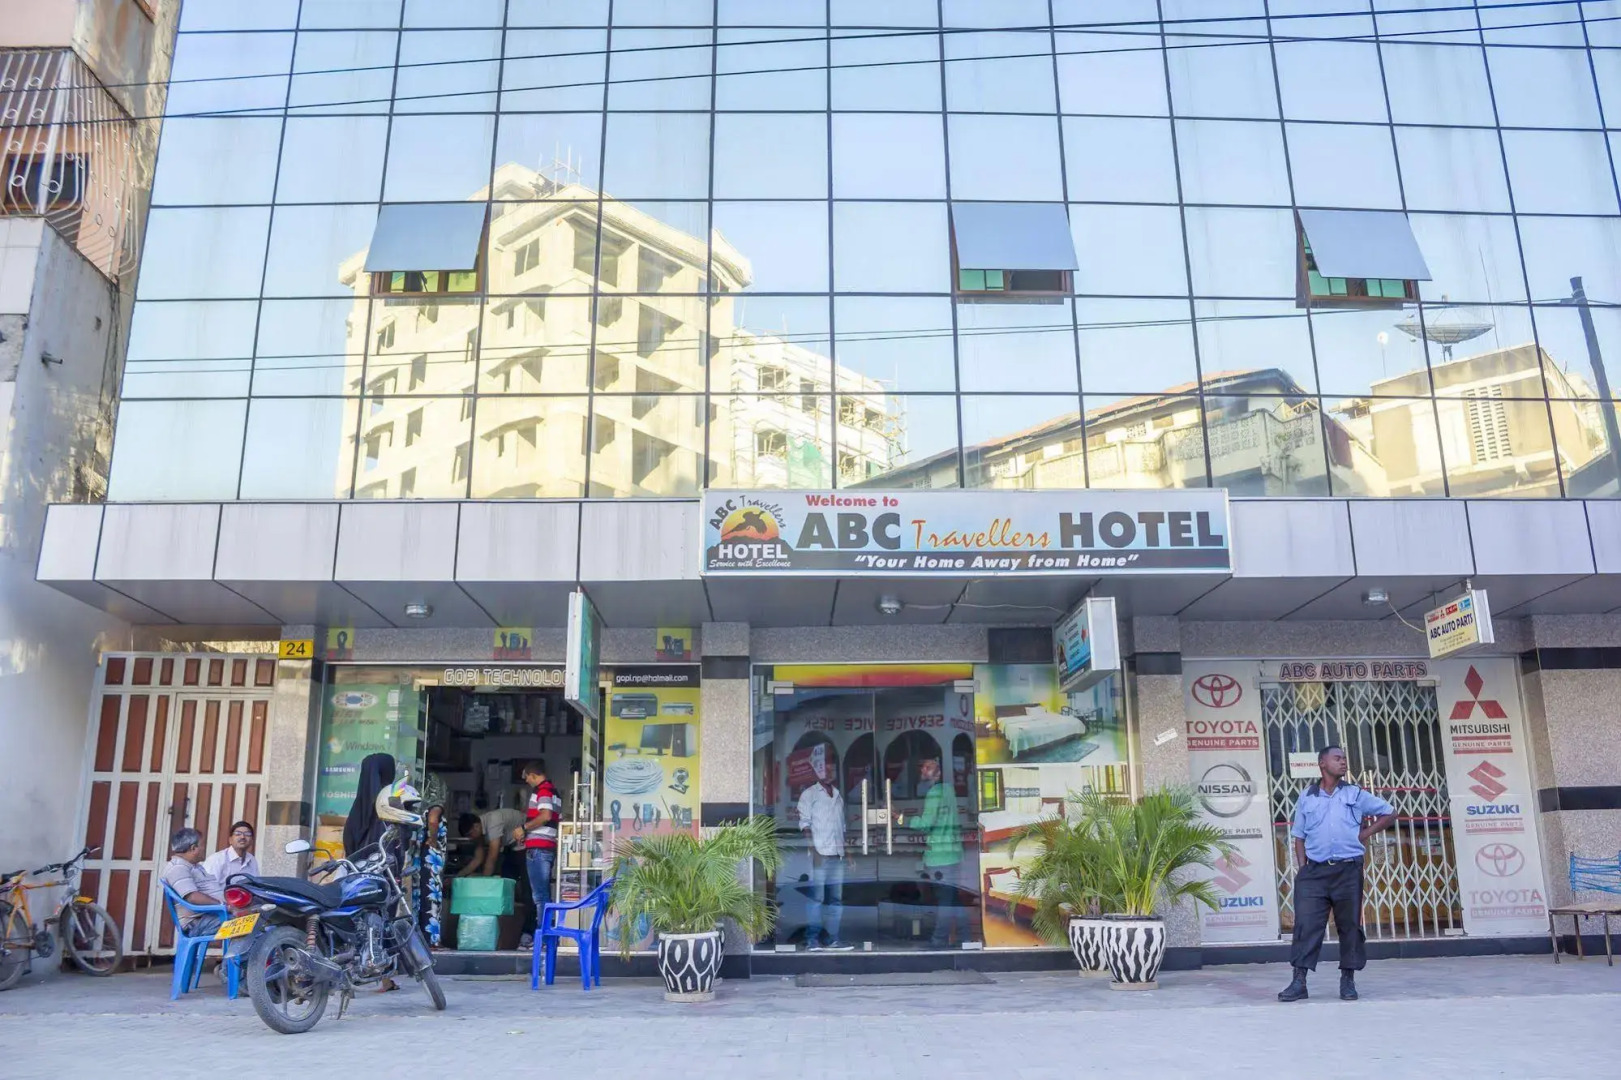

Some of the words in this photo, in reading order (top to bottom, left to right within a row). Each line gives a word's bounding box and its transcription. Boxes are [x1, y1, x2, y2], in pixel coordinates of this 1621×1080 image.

[806, 495, 877, 506] Welcome
[882, 496, 899, 506] to
[709, 499, 737, 530] ABC
[739, 495, 786, 528] Travellers
[796, 512, 901, 550] ABC
[911, 518, 1051, 550] Travellers
[1059, 511, 1223, 548] HOTEL
[719, 544, 788, 559] HOTEL
[709, 559, 735, 568] Service
[737, 559, 753, 567] with
[756, 558, 791, 567] Excellence
[913, 556, 964, 568] Home
[971, 556, 1021, 570] Away
[1028, 554, 1070, 568] from
[1430, 627, 1441, 639] ABC
[1442, 620, 1455, 635] AUTO
[1457, 613, 1473, 629] PARTS
[286, 642, 305, 656] 24
[444, 669, 480, 686] GOPI
[1280, 662, 1317, 680] ABC
[1320, 662, 1368, 680] AUTO
[1371, 661, 1427, 679] PARTS
[1186, 720, 1258, 734] TOYOTA
[1450, 724, 1511, 734] MITSUBISHI
[345, 741, 386, 751] Windows
[1229, 738, 1258, 746] PARTS
[1198, 784, 1251, 794] NISSAN
[1466, 804, 1520, 816] SUZUKI
[1218, 896, 1264, 908] UZUKI
[1469, 889, 1543, 905] TOYOTA
